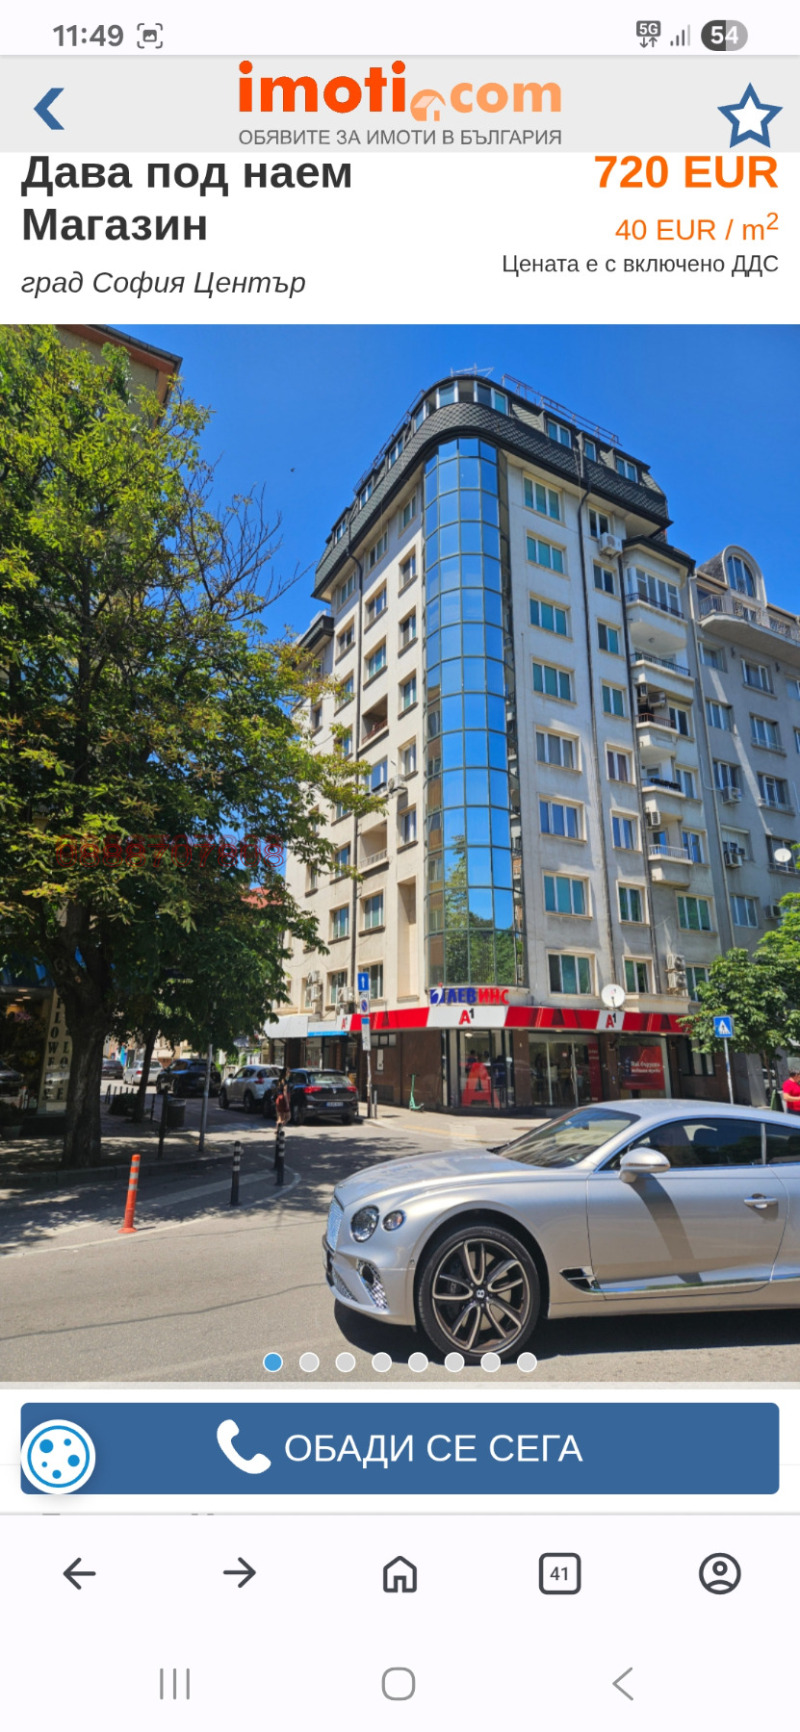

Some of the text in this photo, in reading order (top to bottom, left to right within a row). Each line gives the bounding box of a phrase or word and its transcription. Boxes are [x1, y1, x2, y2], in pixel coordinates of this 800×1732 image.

[53, 25, 124, 47] 11:49
[639, 22, 659, 35] 5G
[710, 25, 739, 45] 54
[239, 129, 562, 145] ОБЯВИТЕ ЗА ИМОТИ В БЪЛГАРИЯ
[21, 156, 352, 198] Дава под наем
[595, 155, 779, 189] 720 EUR
[22, 208, 207, 241] Магазин
[615, 219, 647, 241] 40
[657, 219, 716, 241] EUR
[724, 218, 735, 241] /
[502, 254, 779, 278] Цената е с включено ДДС
[21, 271, 306, 300] град София Център
[458, 1007, 475, 1026] A1
[284, 1433, 584, 1469] ОБАДИ СЕ СЕГА
[549, 1566, 569, 1582] 41
